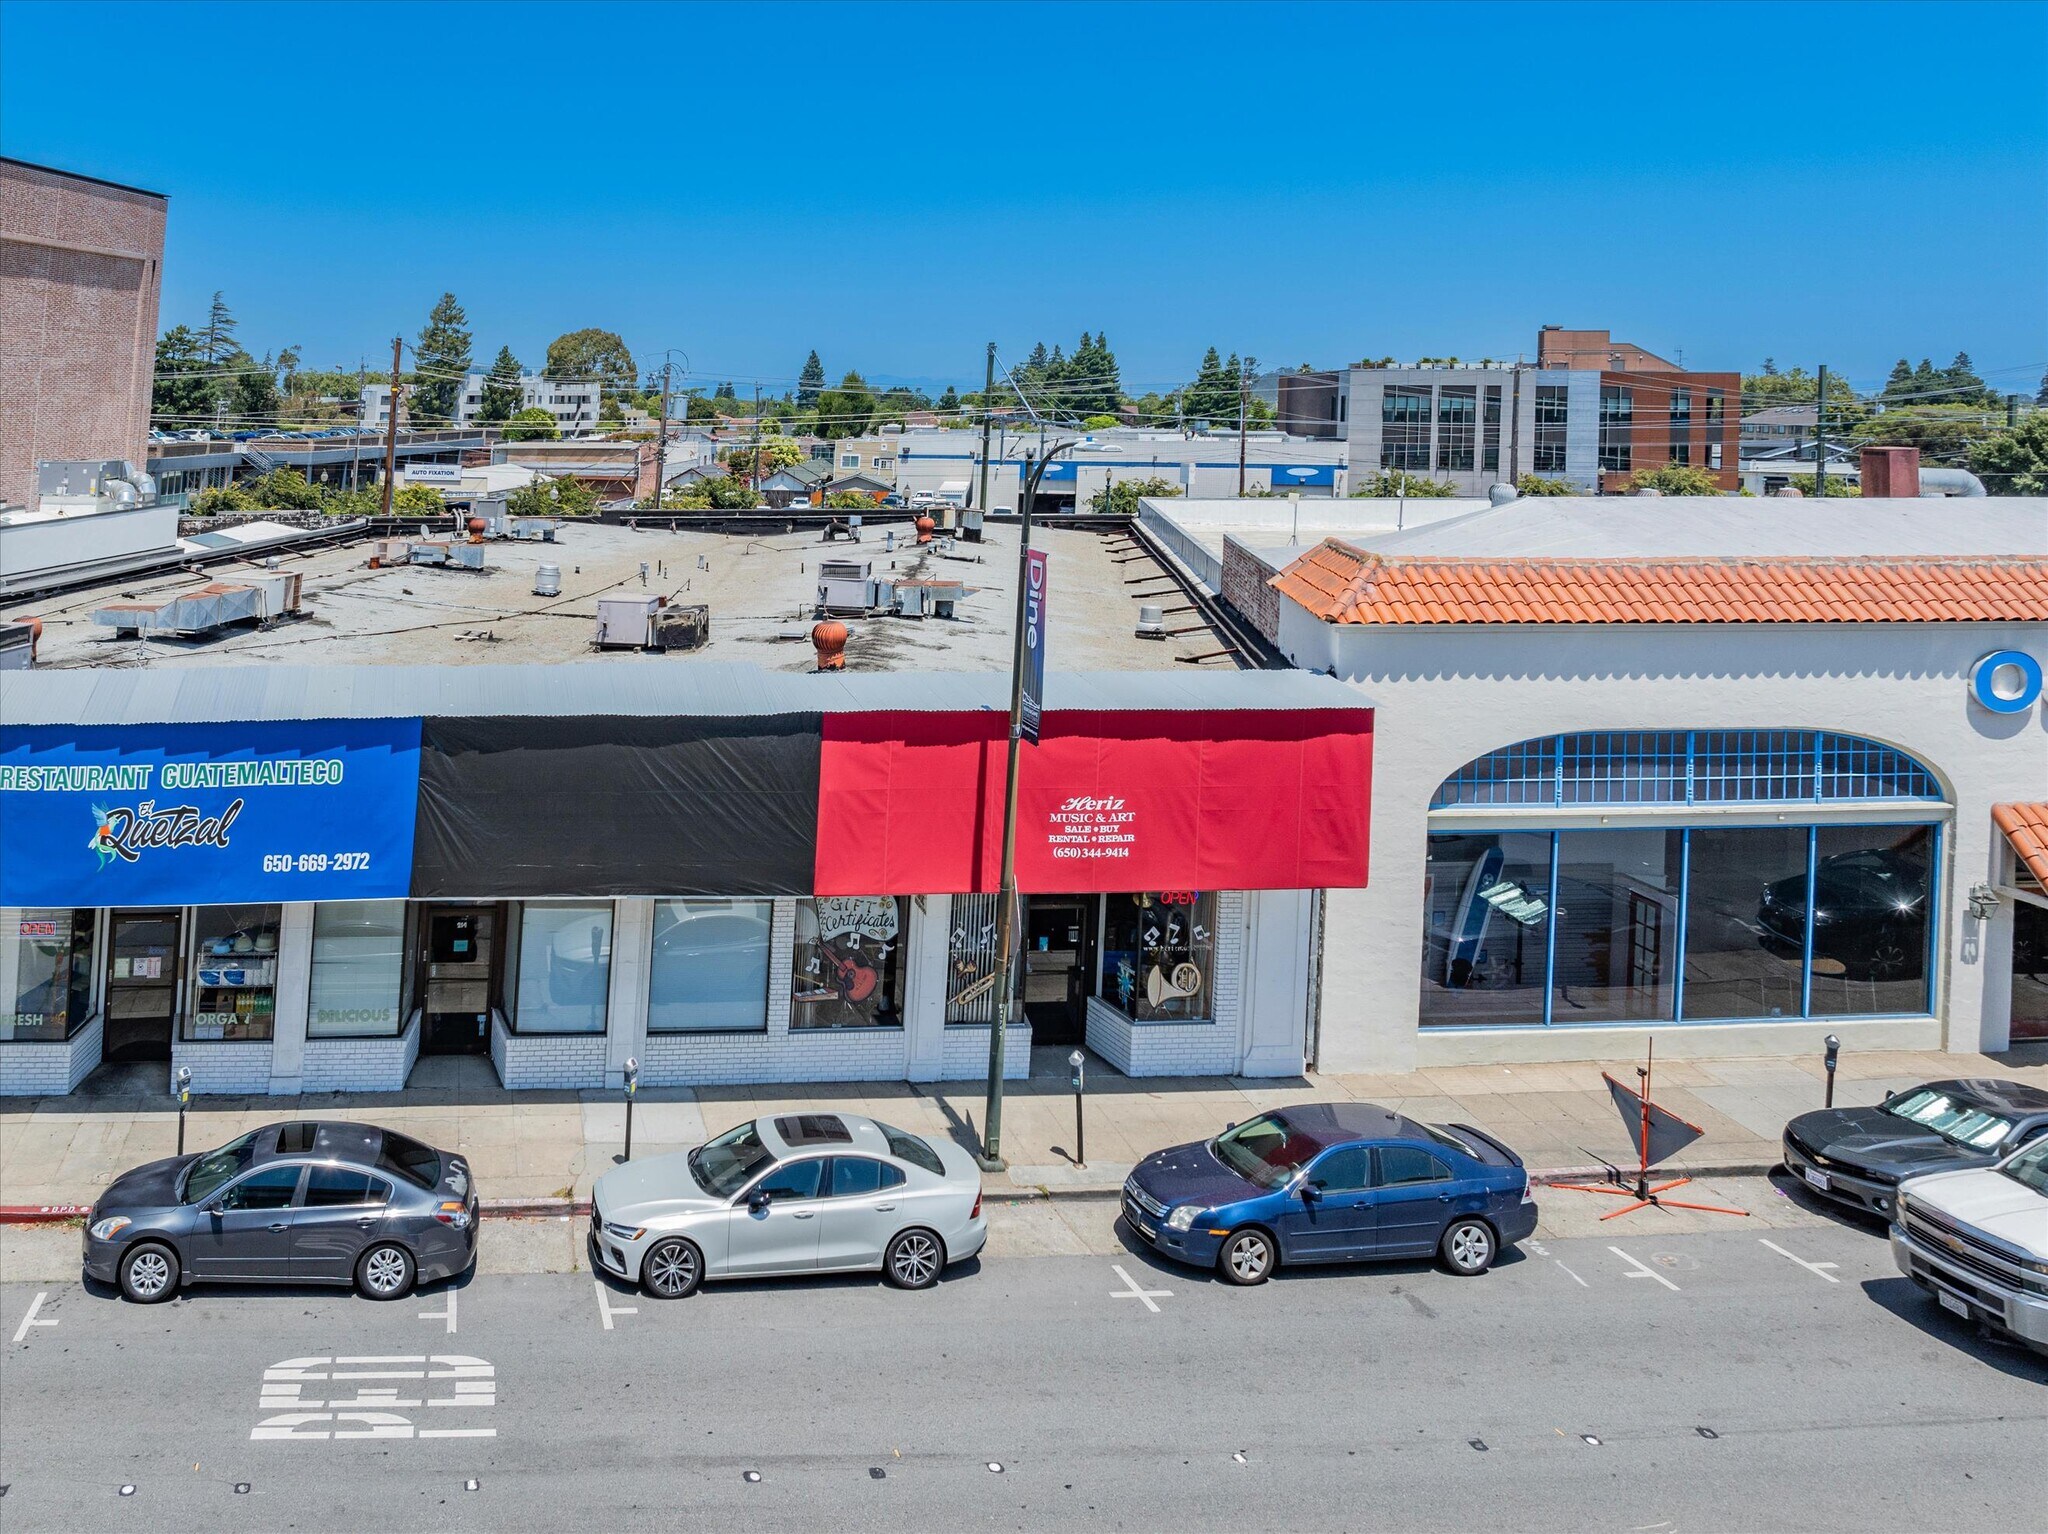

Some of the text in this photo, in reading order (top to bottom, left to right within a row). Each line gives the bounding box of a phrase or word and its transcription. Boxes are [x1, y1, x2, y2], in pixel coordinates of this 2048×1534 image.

[1027, 559, 1043, 650] Dine
[0, 759, 344, 792] RESTAURANT GUATEMALTECO
[138, 799, 156, 816] El
[1060, 796, 1126, 811] Heriz
[1049, 812, 1136, 823] MUSIC & ART
[100, 798, 244, 863] Quetzal
[1064, 825, 1120, 833] SALE BUY
[1048, 834, 1135, 843] RENTAL REPAIR
[263, 852, 370, 873] 650-669-2972
[830, 898, 878, 912] GIFT
[1161, 891, 1197, 904] OPEN
[20, 922, 55, 935] OPEN
[317, 1008, 391, 1023] DELICIOUS
